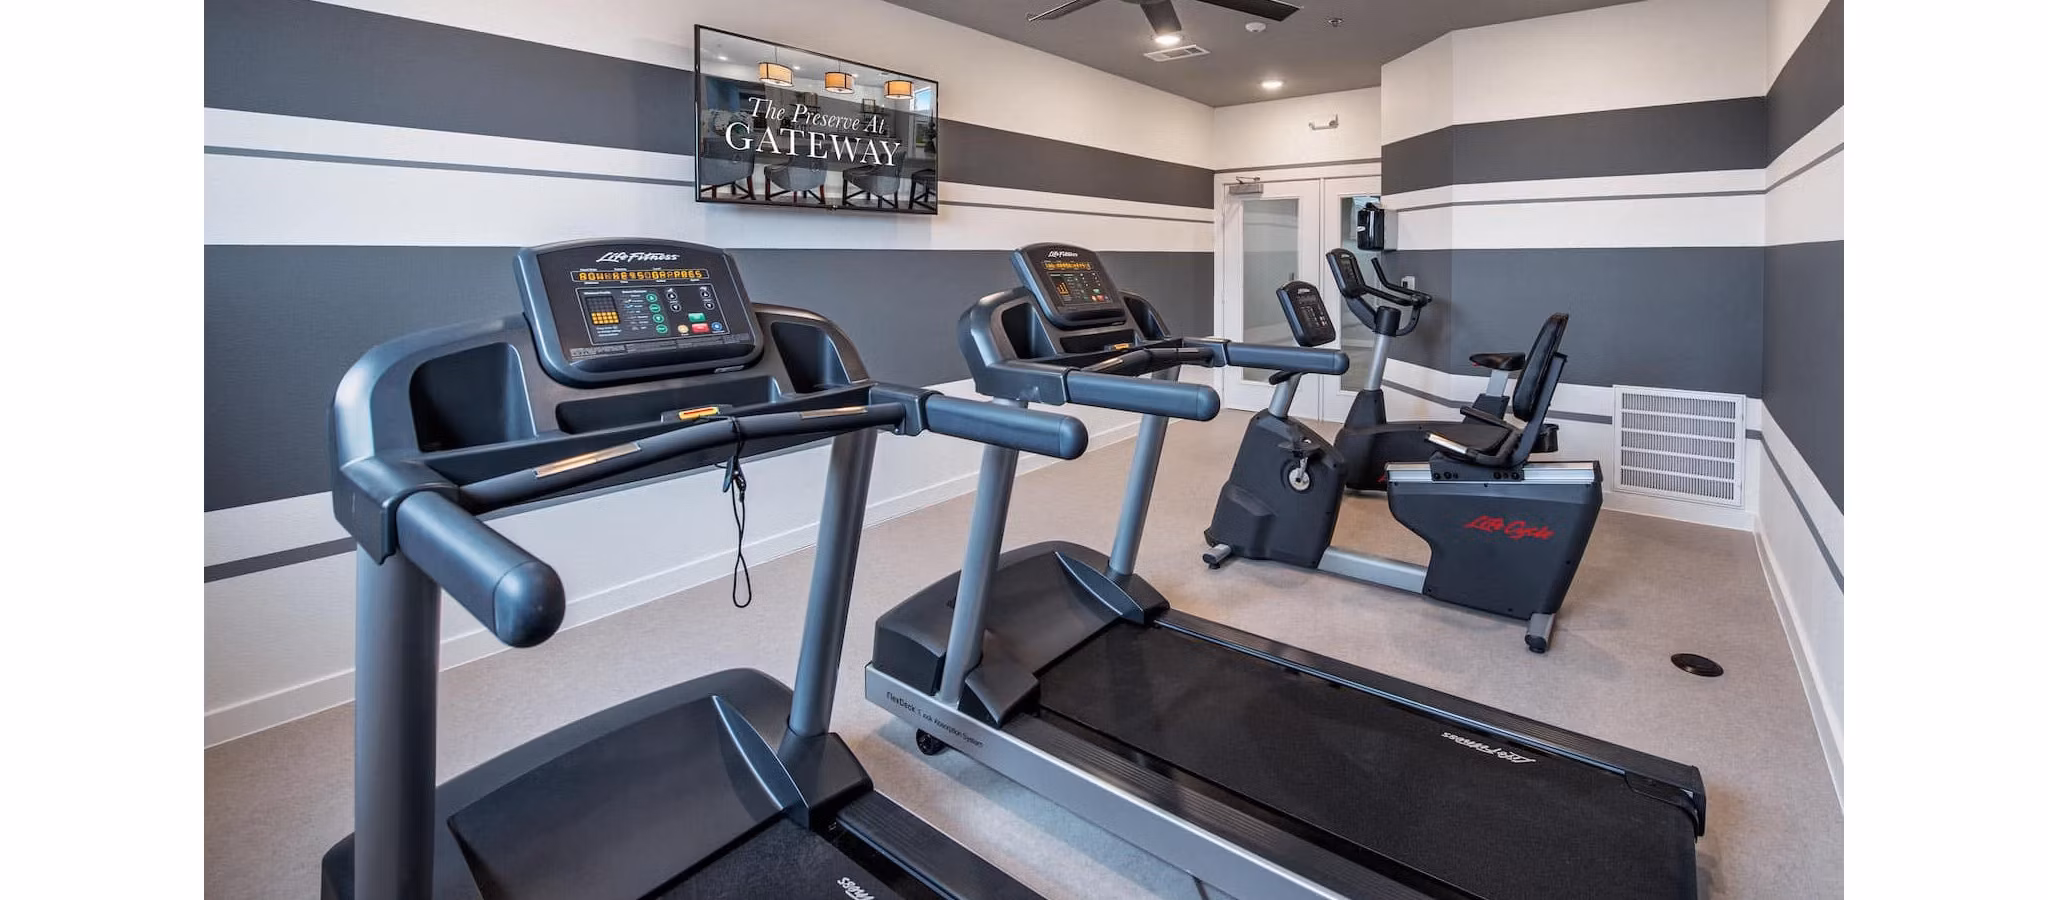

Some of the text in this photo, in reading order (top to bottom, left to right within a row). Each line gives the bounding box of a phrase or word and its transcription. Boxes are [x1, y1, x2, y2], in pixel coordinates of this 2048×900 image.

[748, 96, 886, 135] The Preserve At
[725, 121, 901, 167] GATEWAY
